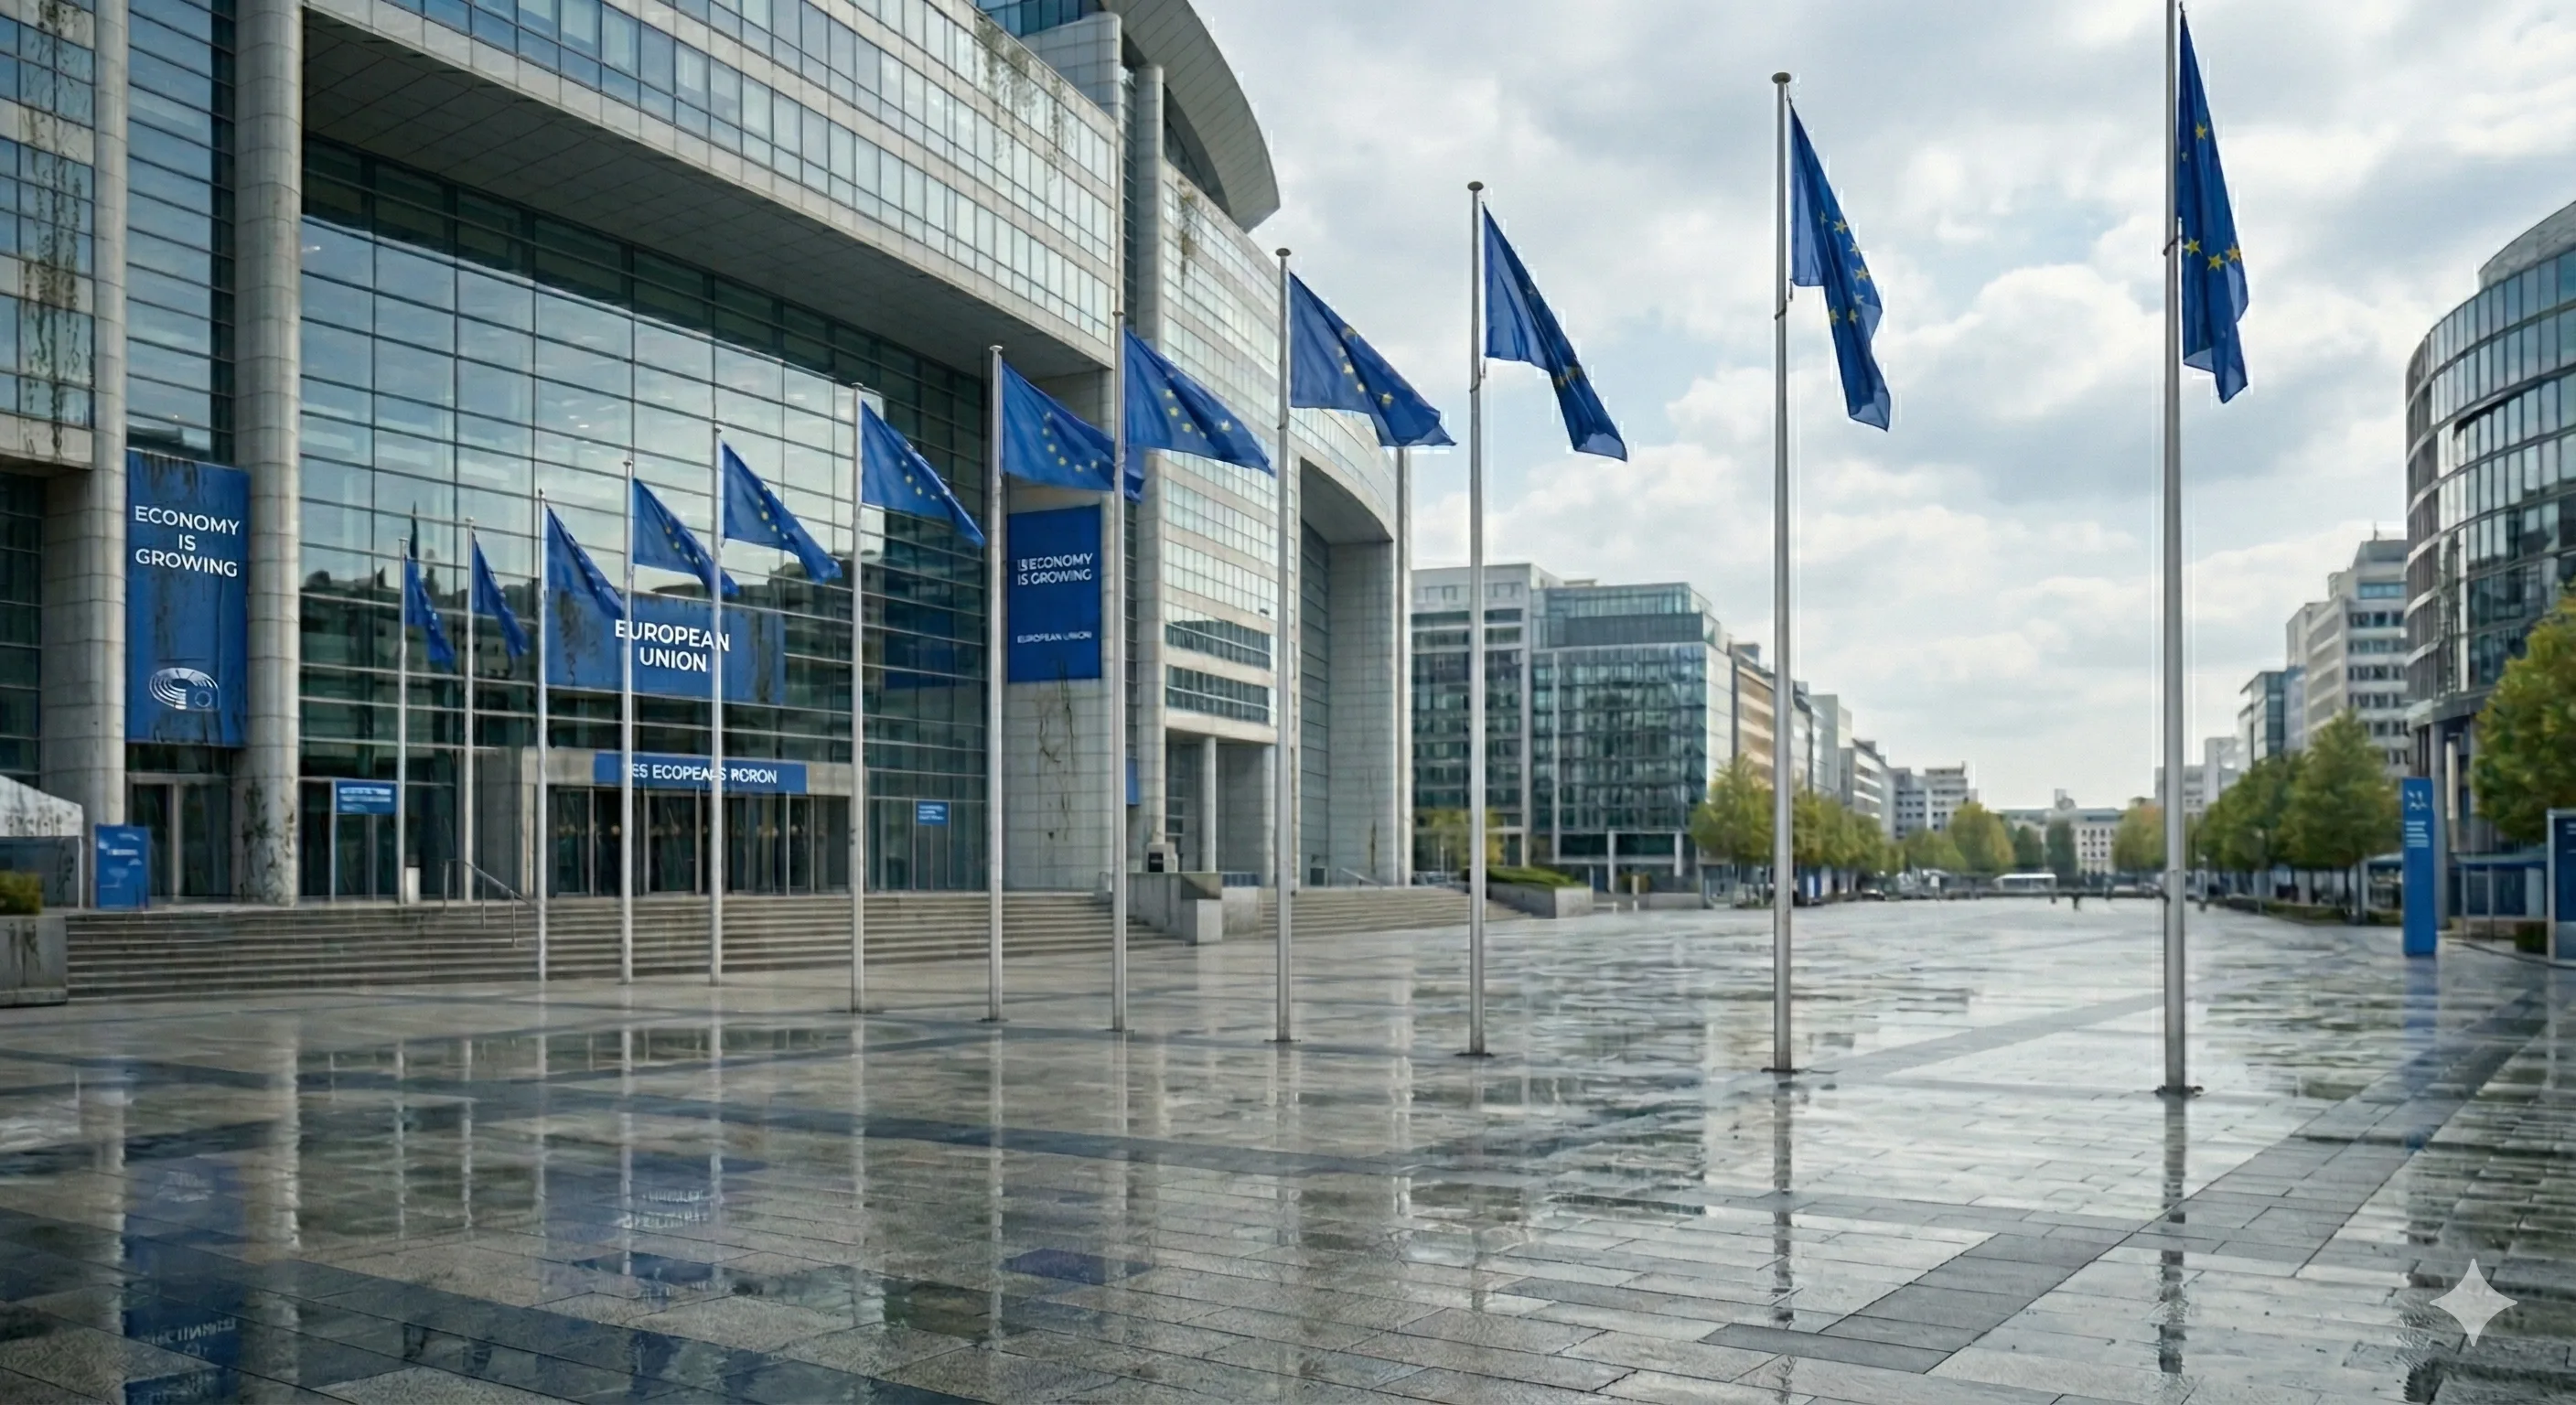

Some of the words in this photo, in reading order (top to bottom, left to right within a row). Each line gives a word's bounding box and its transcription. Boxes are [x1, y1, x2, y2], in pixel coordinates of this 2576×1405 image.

[134, 505, 240, 535] ECONOMY
[177, 534, 196, 552] IS
[135, 548, 238, 578] GROWING
[1017, 573, 1028, 585] IS
[1030, 568, 1092, 585] GROWING
[615, 619, 730, 651] EUROPEAN
[639, 647, 707, 672] UNION
